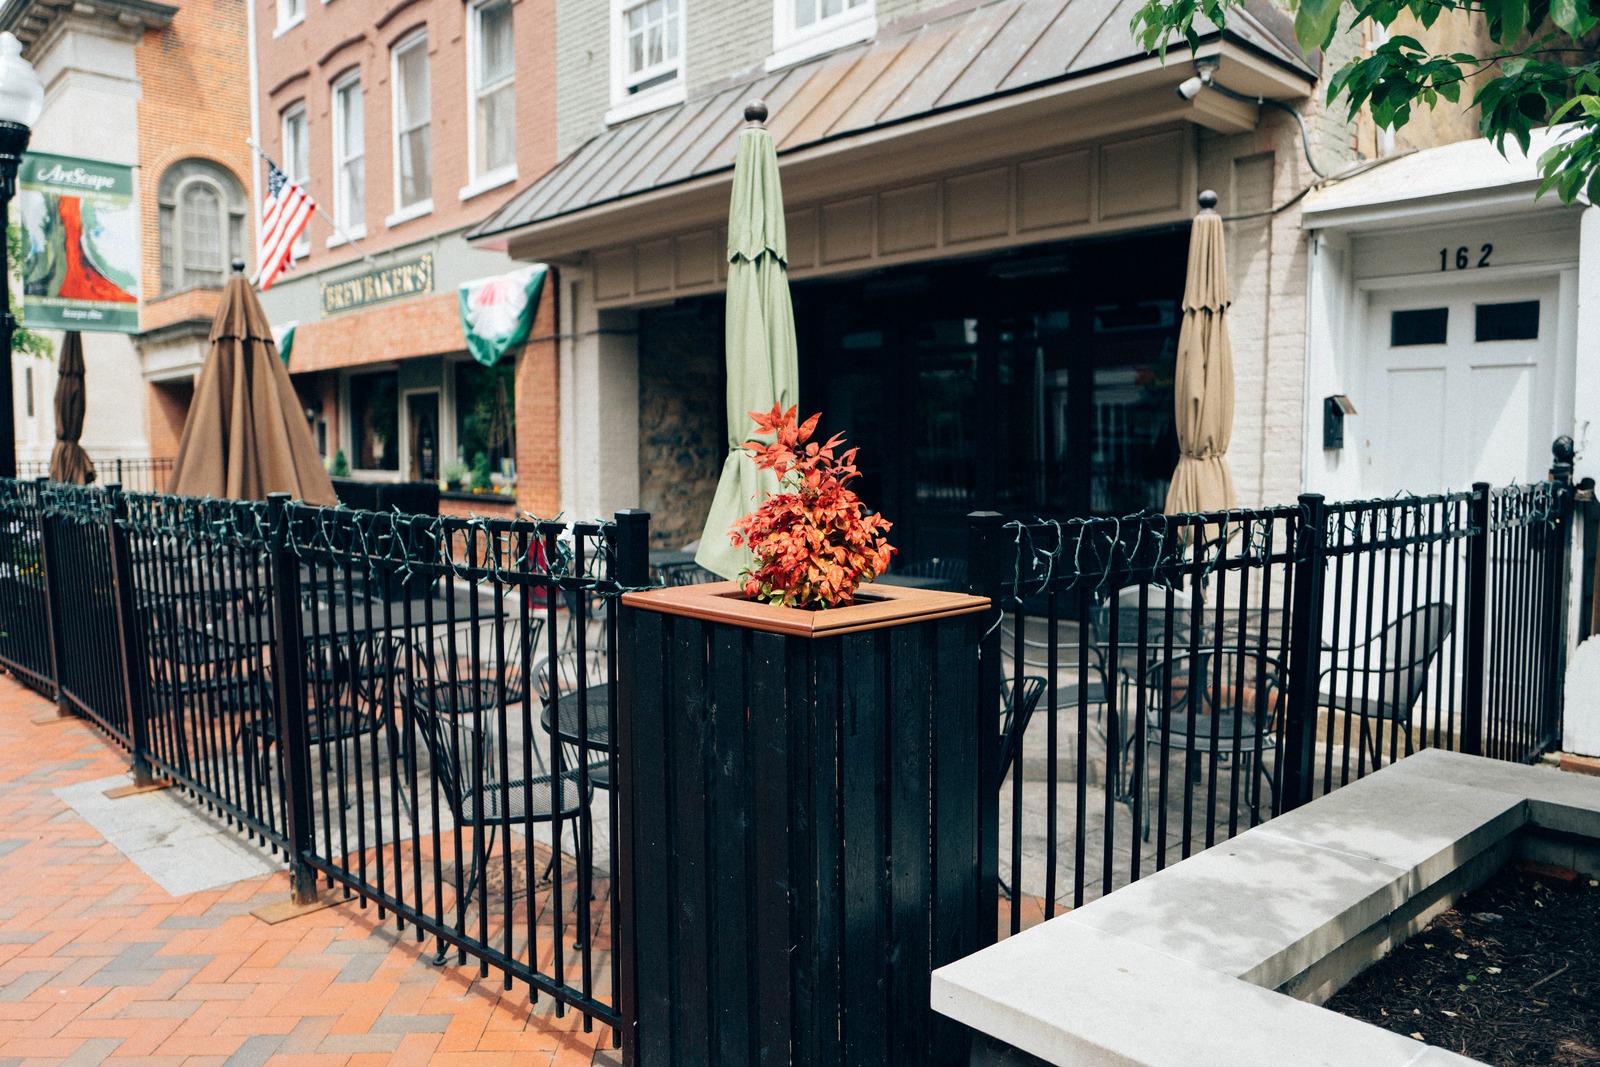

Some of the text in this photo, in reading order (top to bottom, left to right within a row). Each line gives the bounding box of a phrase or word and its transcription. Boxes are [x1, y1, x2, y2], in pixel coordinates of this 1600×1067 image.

[37, 164, 115, 191] ArtScape
[1440, 243, 1493, 271] 162
[326, 264, 427, 309] BREWBAKER'S
